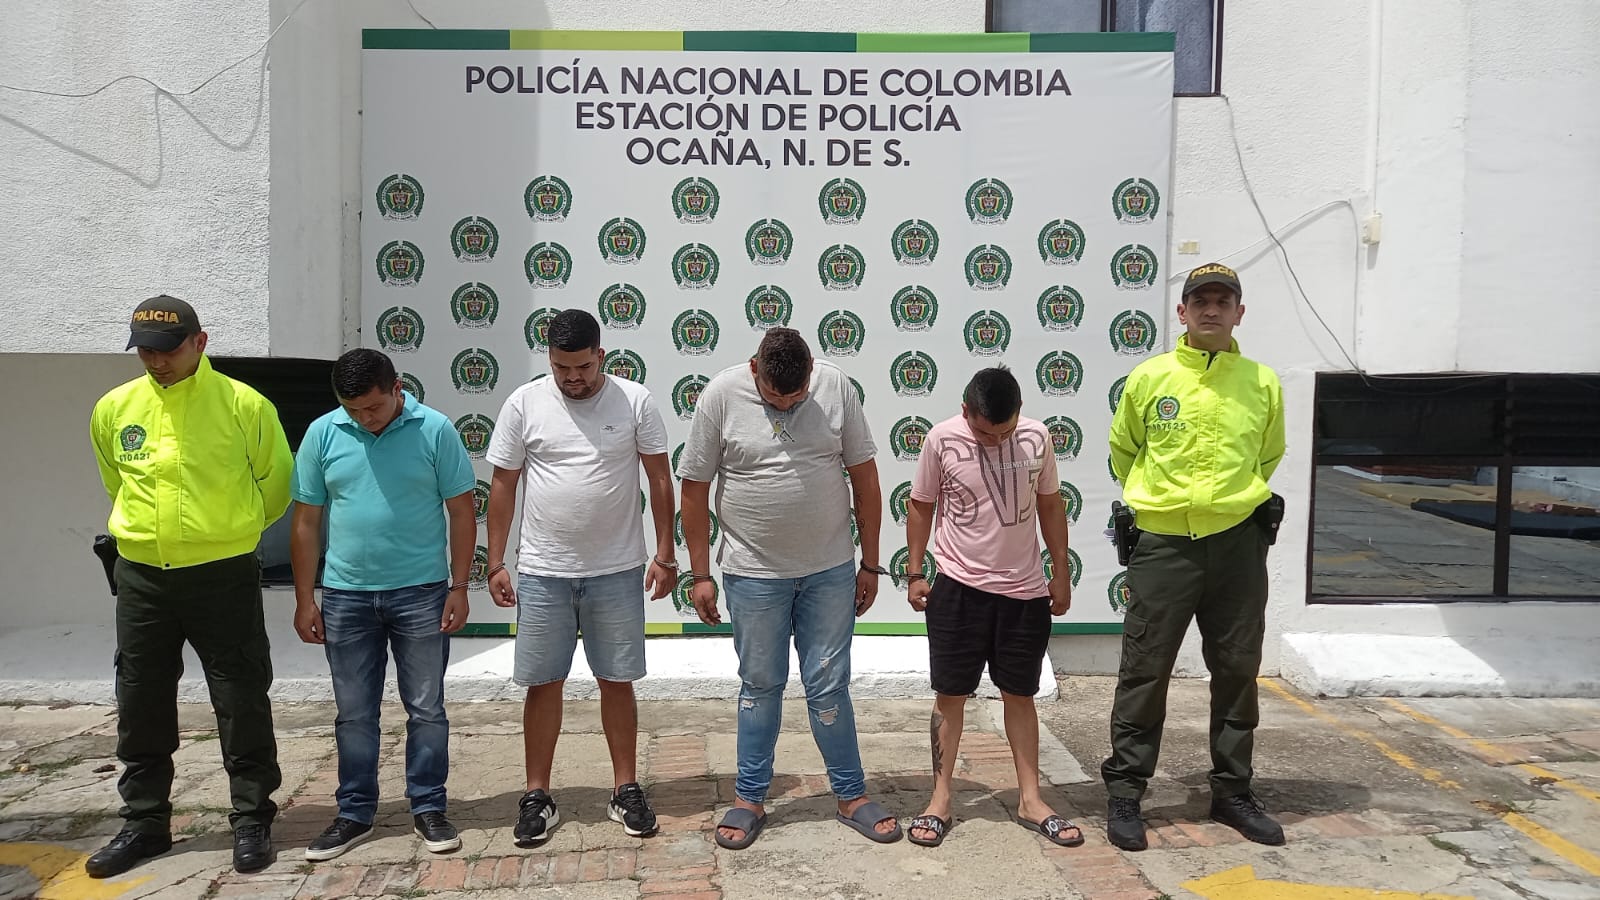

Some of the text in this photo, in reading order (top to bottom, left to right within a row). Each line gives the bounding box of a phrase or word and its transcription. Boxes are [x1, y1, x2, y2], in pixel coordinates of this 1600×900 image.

[465, 58, 1072, 97] POLICÍA NACIONAL DE COLOMBIA
[576, 94, 962, 132] ESTACIÓN DE POLICÍA
[626, 130, 910, 170] OCAÑA, N. DE S.
[1191, 265, 1236, 280] POLICIA
[133, 310, 180, 324] POLICIA
